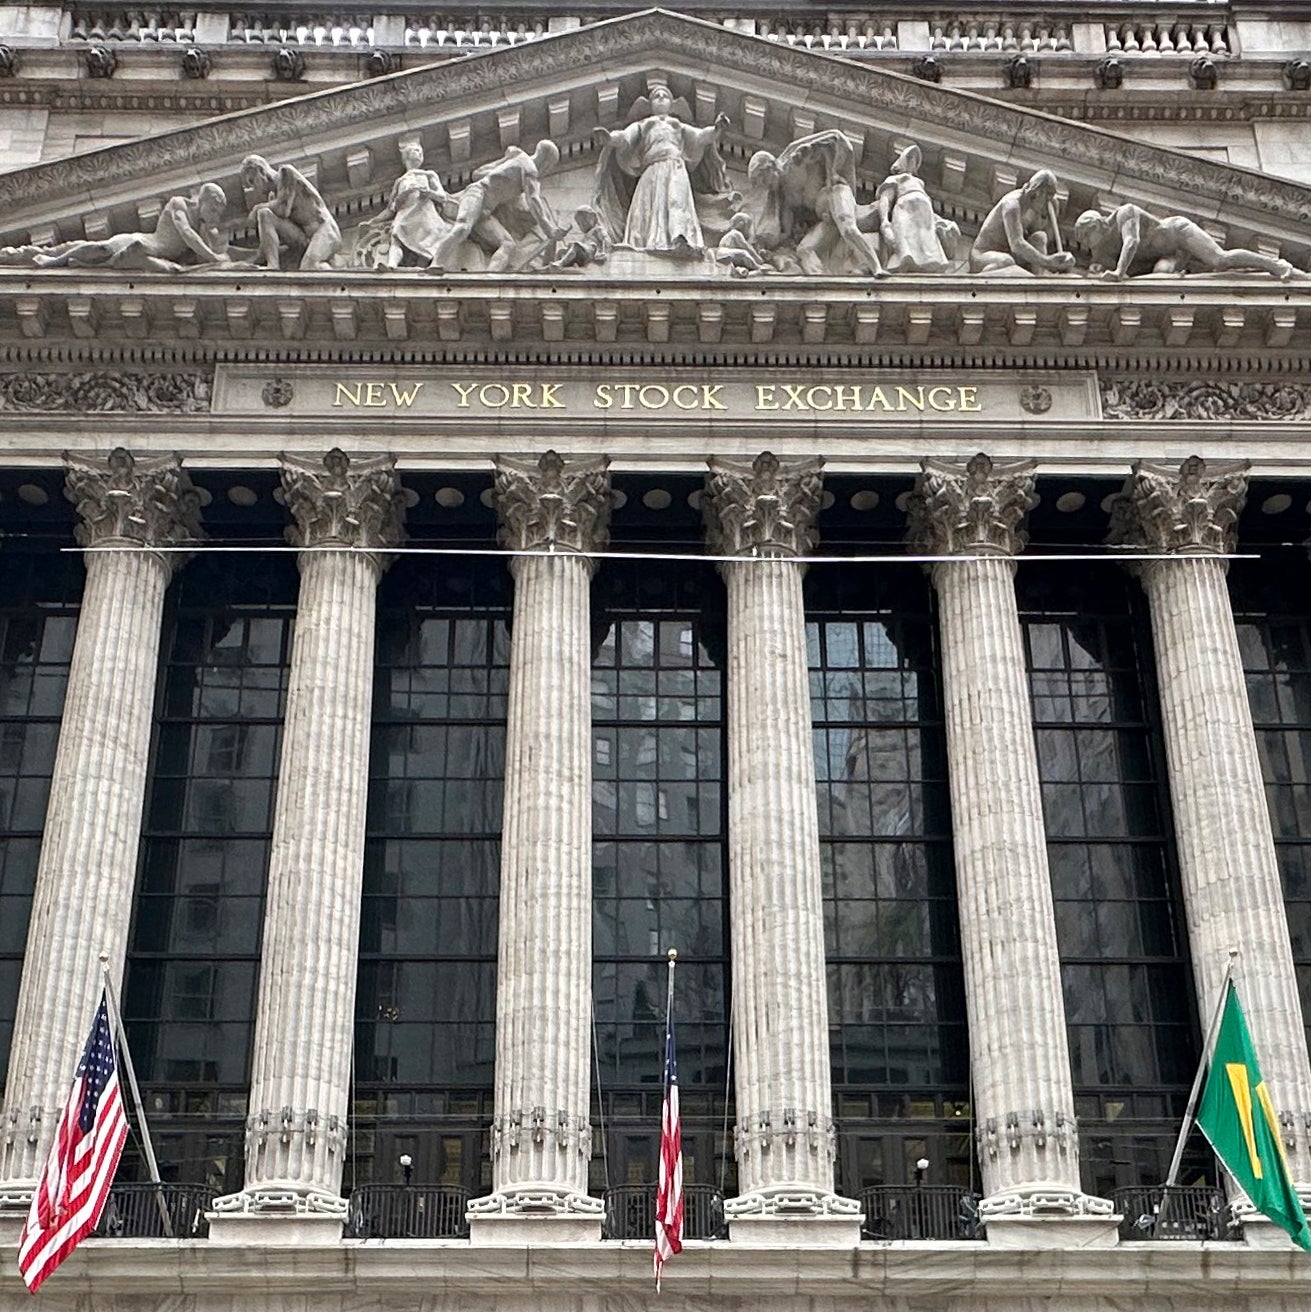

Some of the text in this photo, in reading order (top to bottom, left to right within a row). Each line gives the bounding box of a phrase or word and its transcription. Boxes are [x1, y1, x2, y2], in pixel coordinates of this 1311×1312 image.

[333, 382, 982, 412] NEW YORK STOCK EXCHANGE
